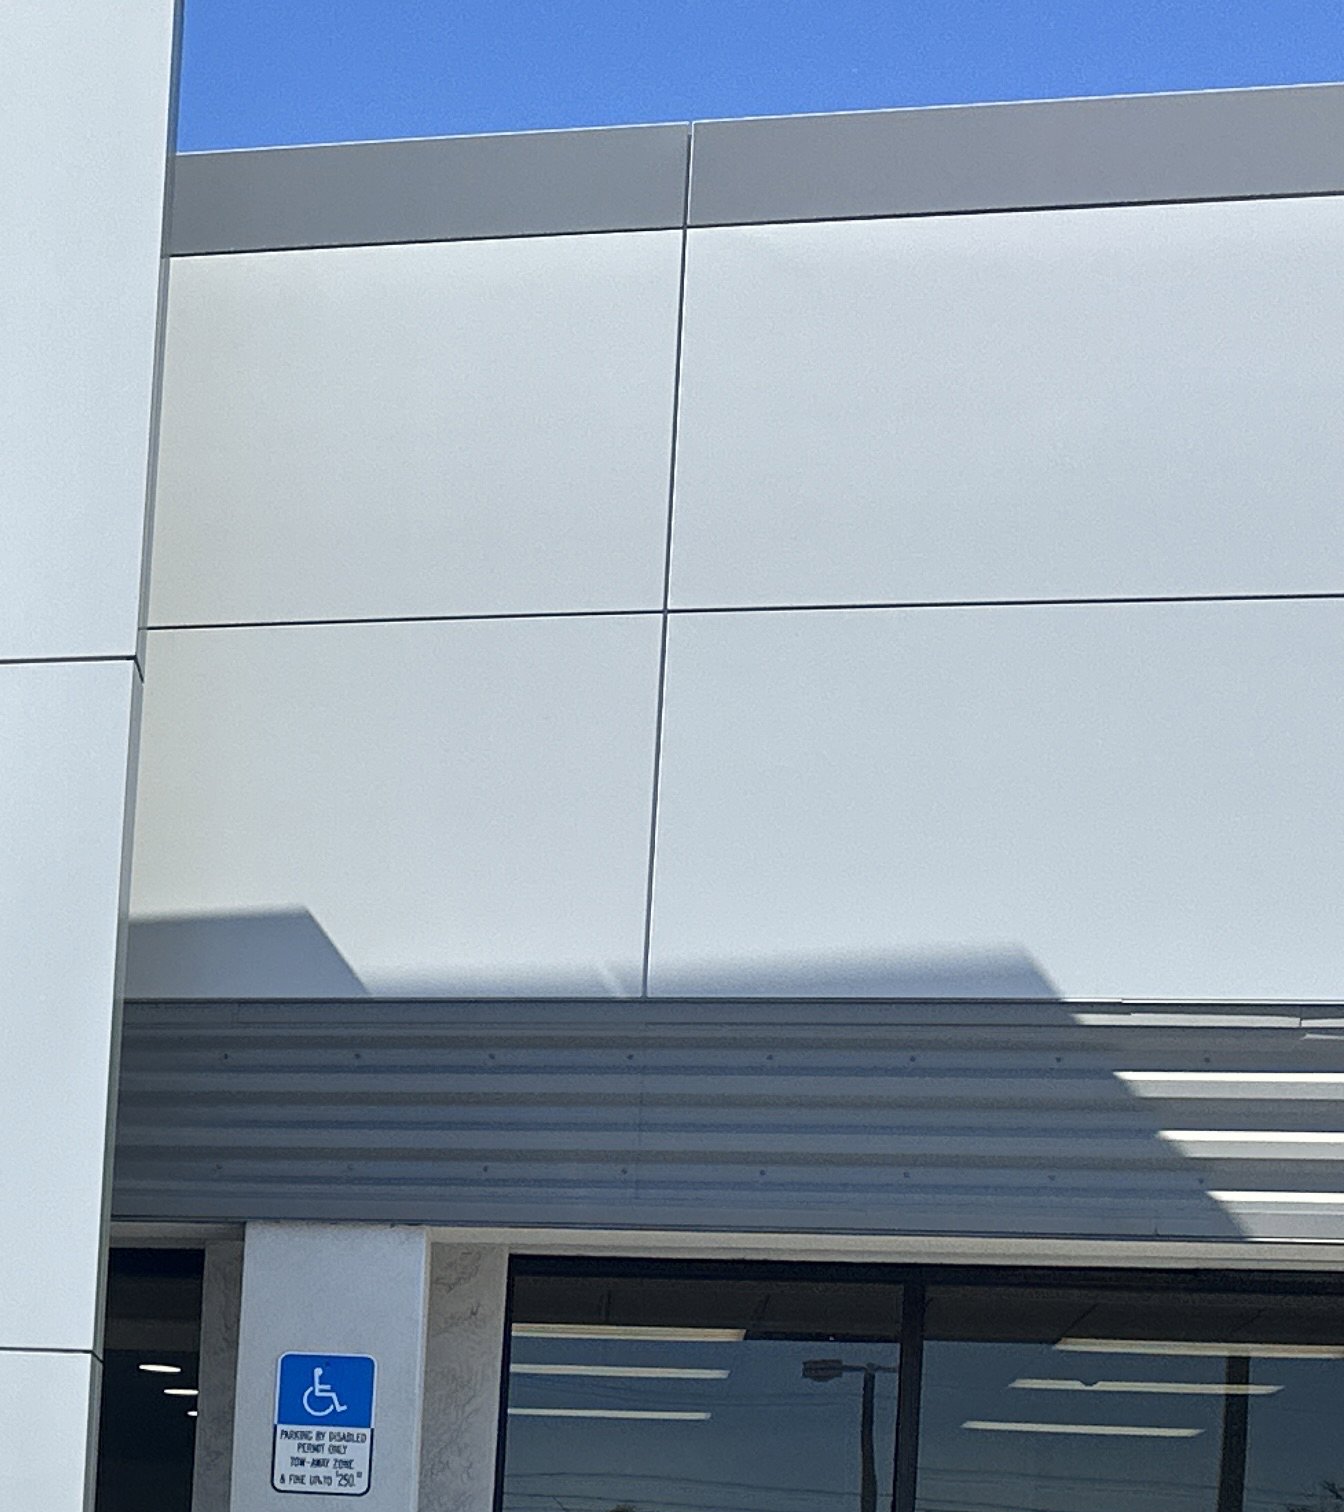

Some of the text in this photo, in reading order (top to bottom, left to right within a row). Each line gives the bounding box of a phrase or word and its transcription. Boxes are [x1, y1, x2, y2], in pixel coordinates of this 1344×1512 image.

[280, 1429, 367, 1443] PARKING BY DISABLED
[297, 1442, 347, 1454] PERMIT ONLY
[333, 1459, 354, 1469] ZONE
[289, 1474, 306, 1485] FINE
